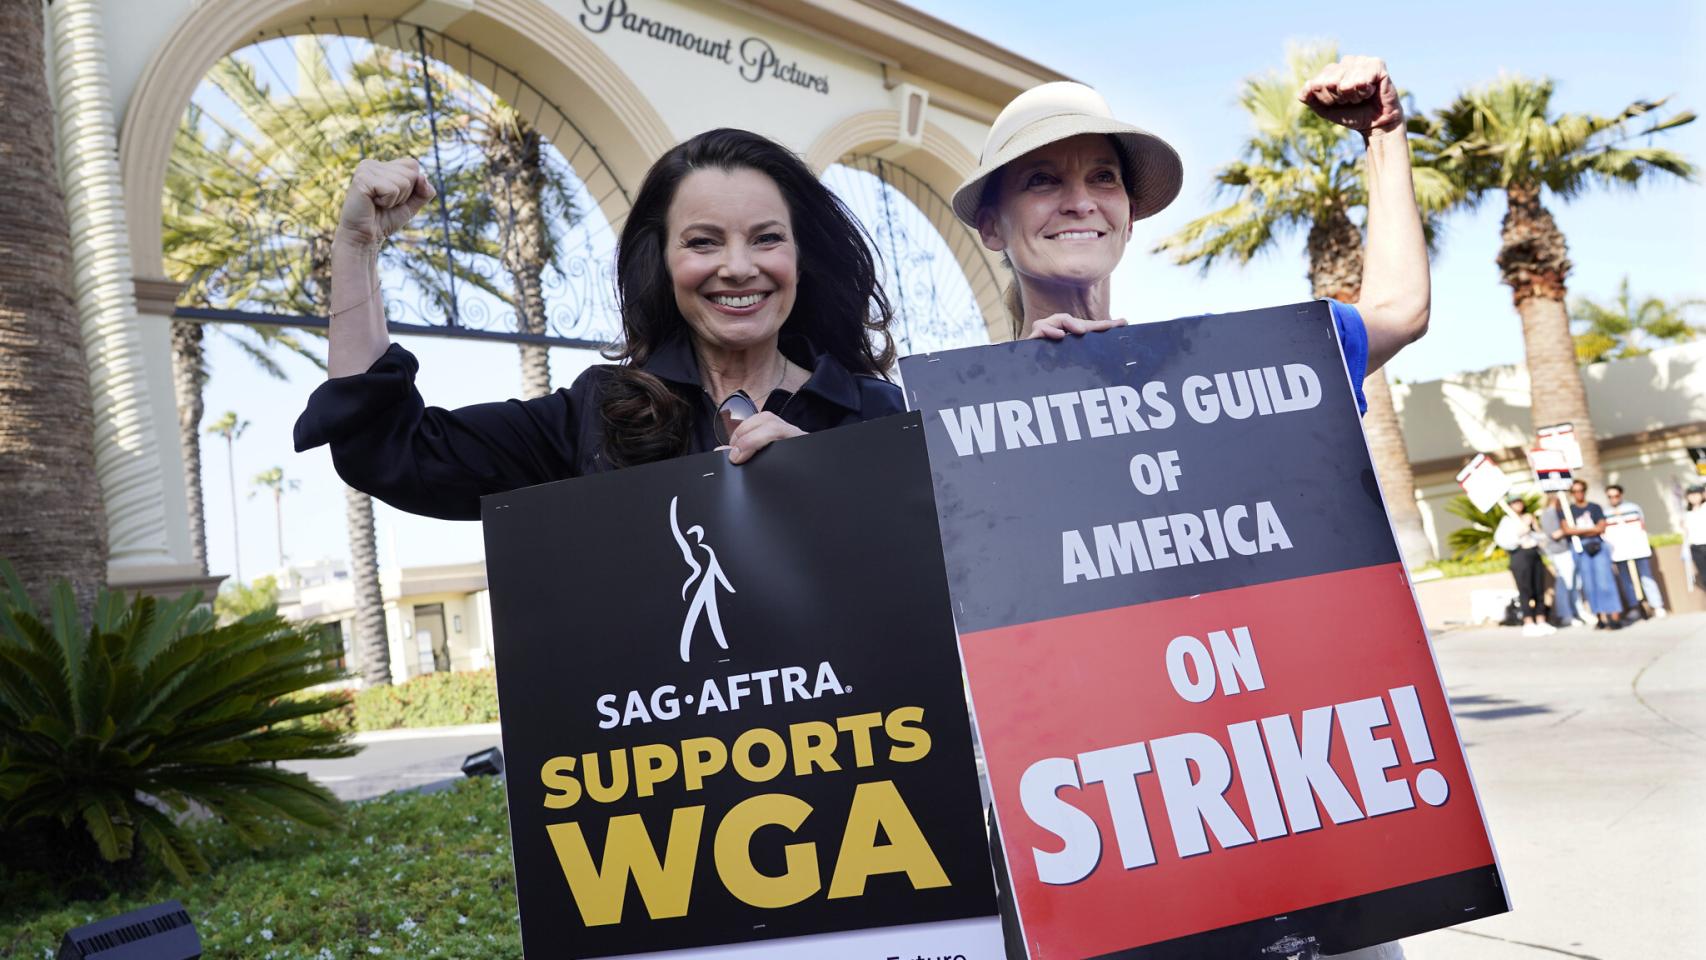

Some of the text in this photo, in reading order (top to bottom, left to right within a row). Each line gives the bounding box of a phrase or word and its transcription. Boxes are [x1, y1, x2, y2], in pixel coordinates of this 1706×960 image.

[579, 0, 828, 94] Paramount Pictures
[939, 363, 1322, 456] WRITERS GUILD
[1129, 450, 1182, 495] OF
[1062, 501, 1293, 584] AMERICA
[1165, 626, 1265, 702] ON
[540, 706, 932, 809] SUPPORTS
[1019, 685, 1449, 885] STRIKE!
[546, 780, 951, 927] WGA
